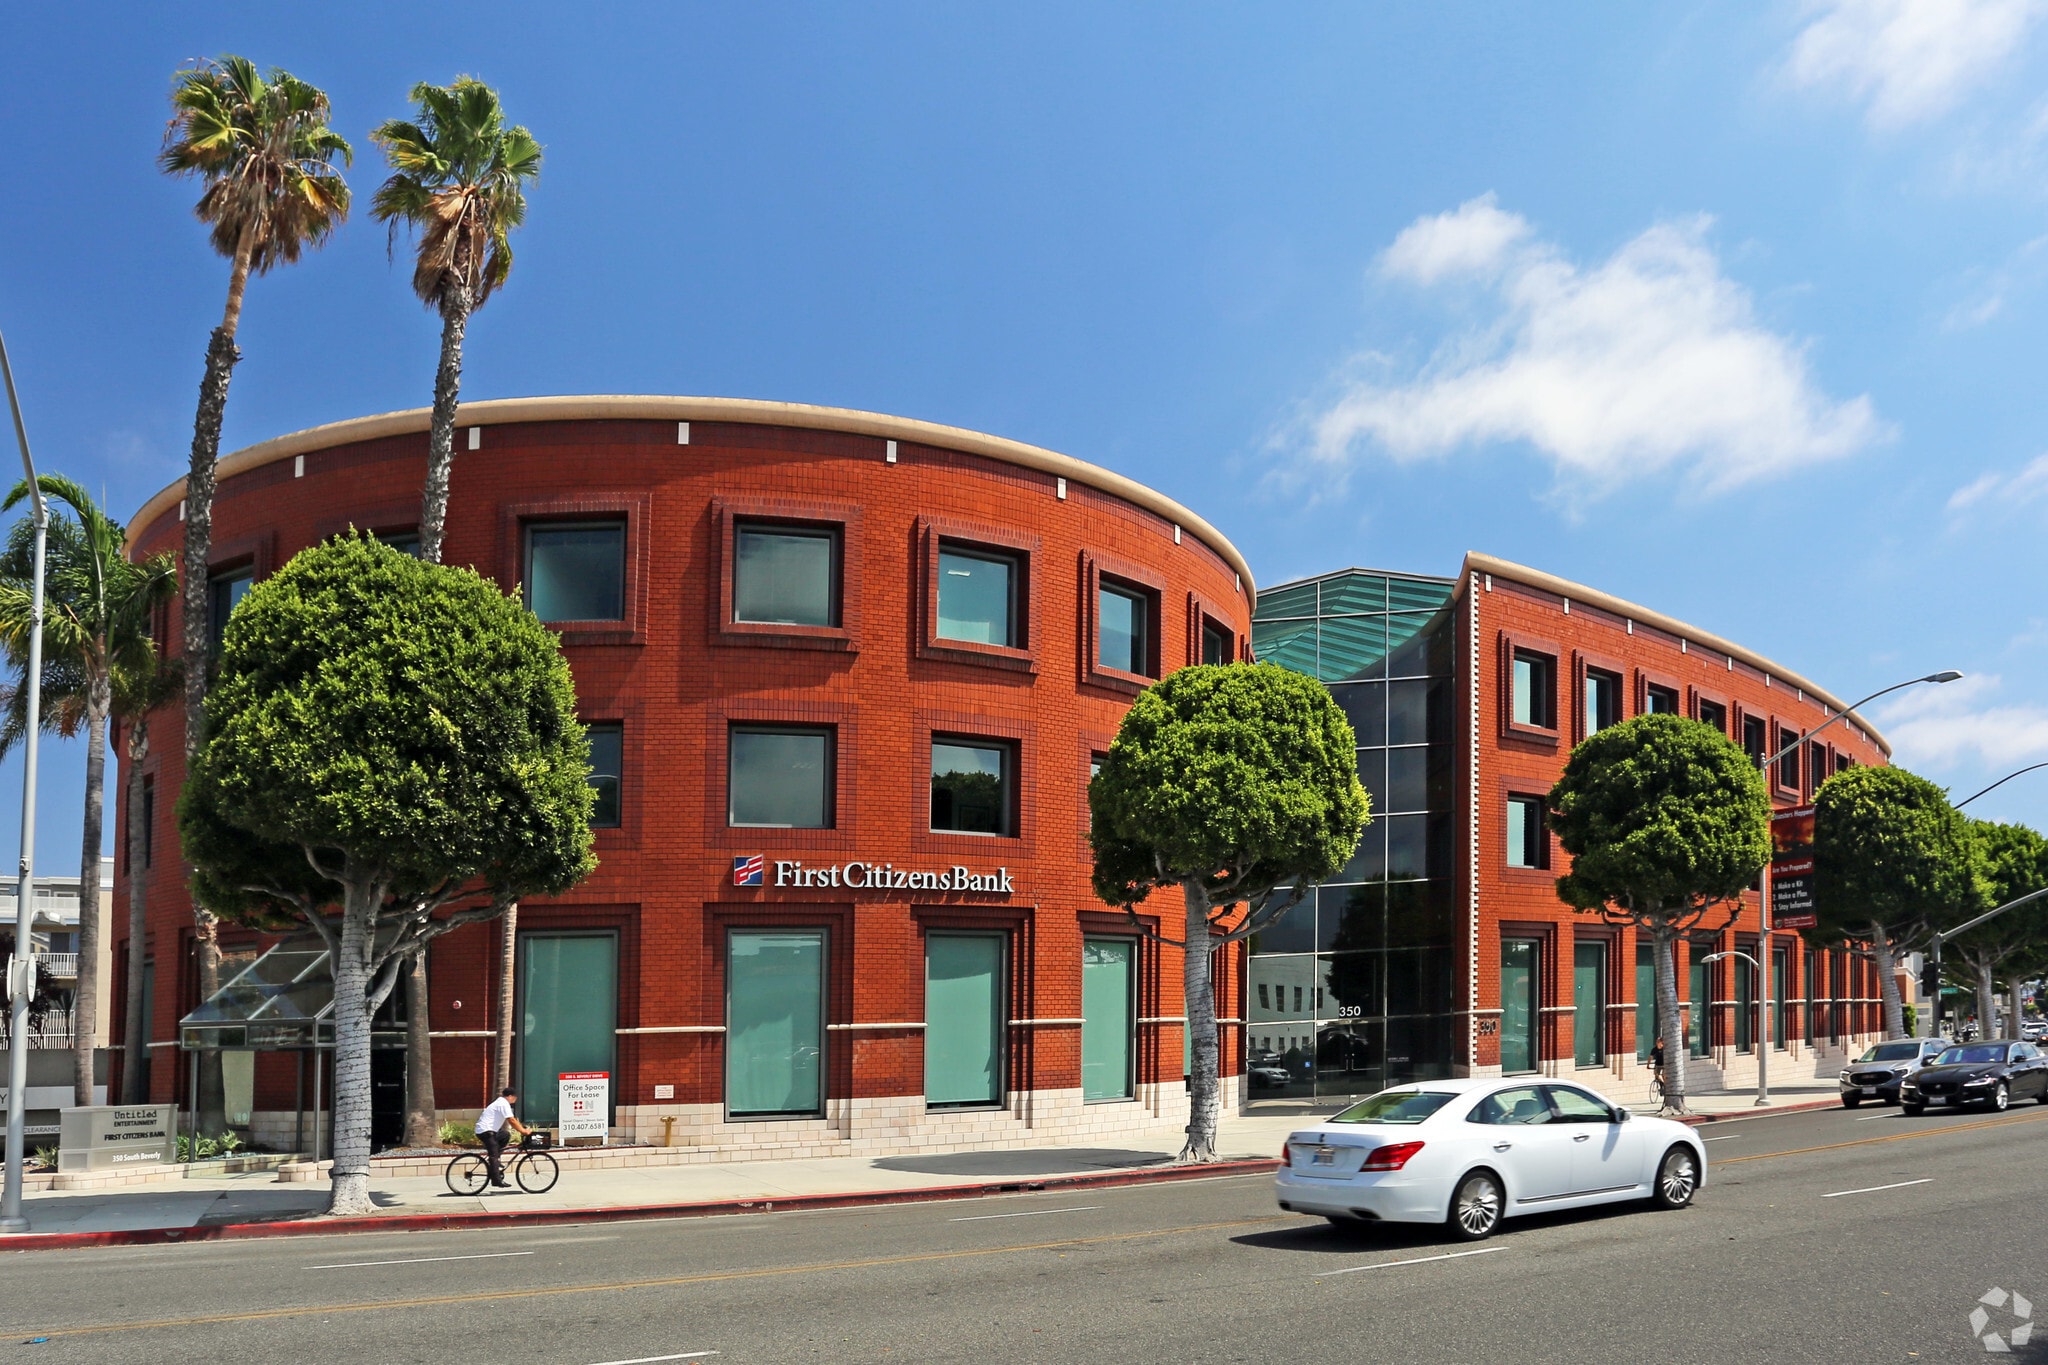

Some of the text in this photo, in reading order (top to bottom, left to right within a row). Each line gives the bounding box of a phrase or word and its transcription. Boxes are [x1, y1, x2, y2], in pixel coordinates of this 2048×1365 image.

[1778, 881, 1791, 889] Make
[1778, 903, 1789, 911] Stay
[1790, 899, 1812, 909] Informed
[1339, 1006, 1361, 1017] 350
[114, 1109, 157, 1119] Untitled
[114, 1119, 157, 1127] ENTERTAINMENT
[563, 1122, 605, 1131] 310.407.6581
[104, 1133, 121, 1141] FIRST
[122, 1132, 149, 1140] CITIZENS
[112, 1151, 161, 1162] 350 South Beverly
